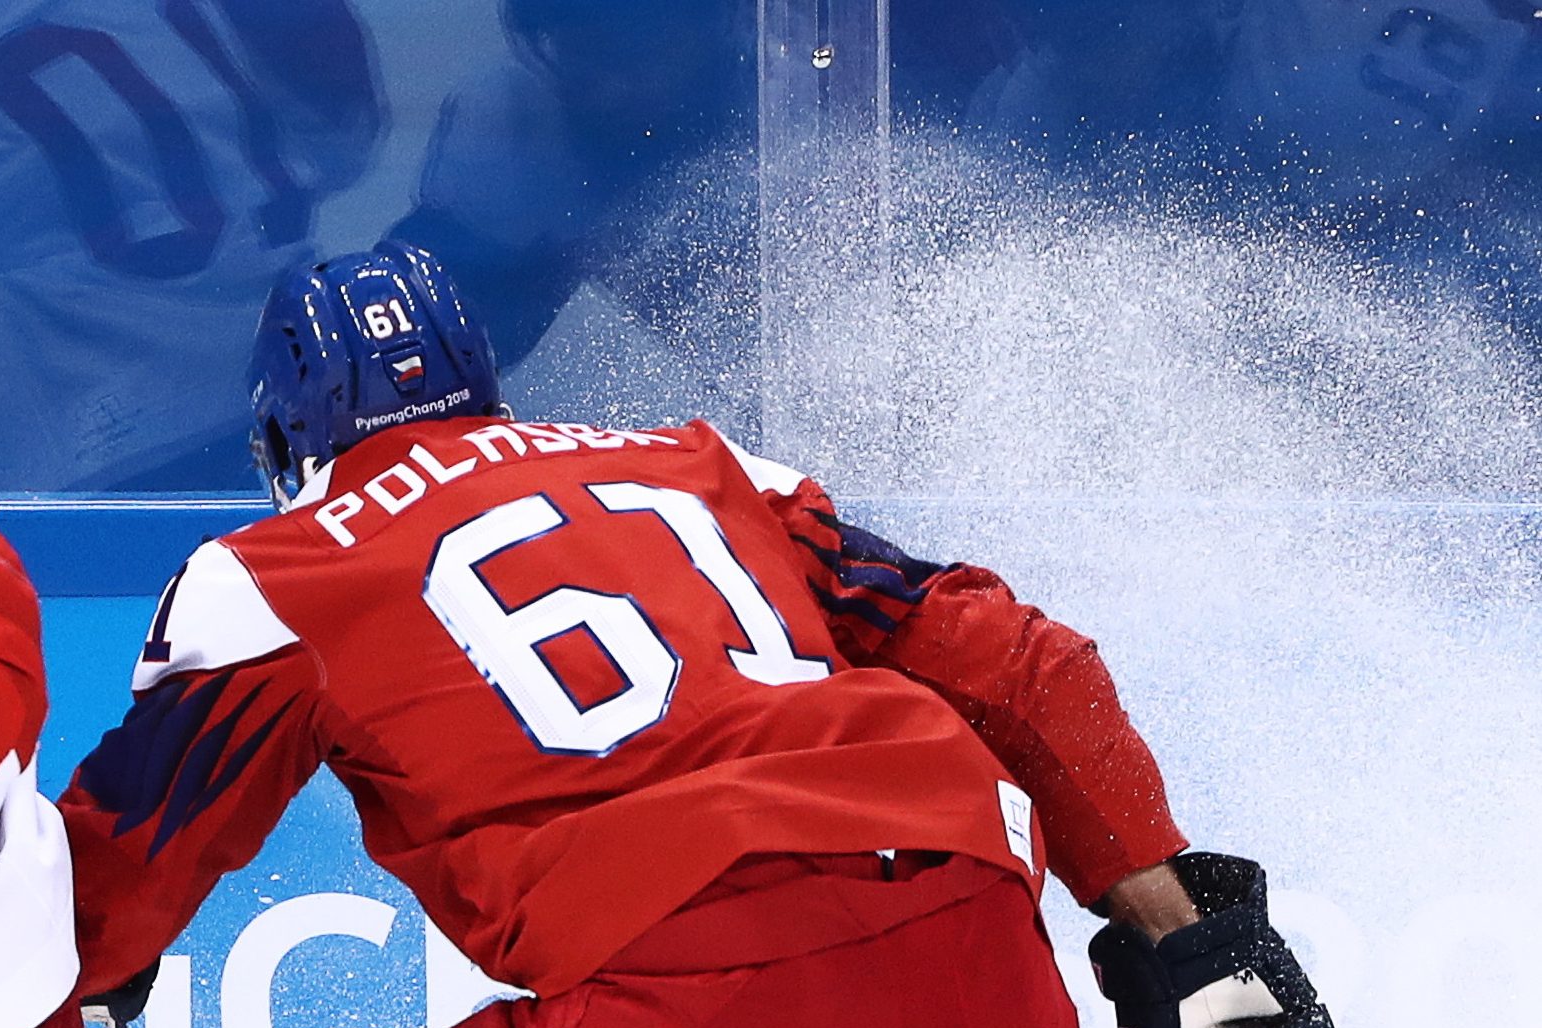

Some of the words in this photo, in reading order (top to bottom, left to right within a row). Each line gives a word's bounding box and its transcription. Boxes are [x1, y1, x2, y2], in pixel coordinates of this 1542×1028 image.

[363, 299, 413, 340] 61
[355, 399, 446, 431] PyeongChang
[445, 388, 470, 407] 2018
[421, 481, 834, 759] 61
